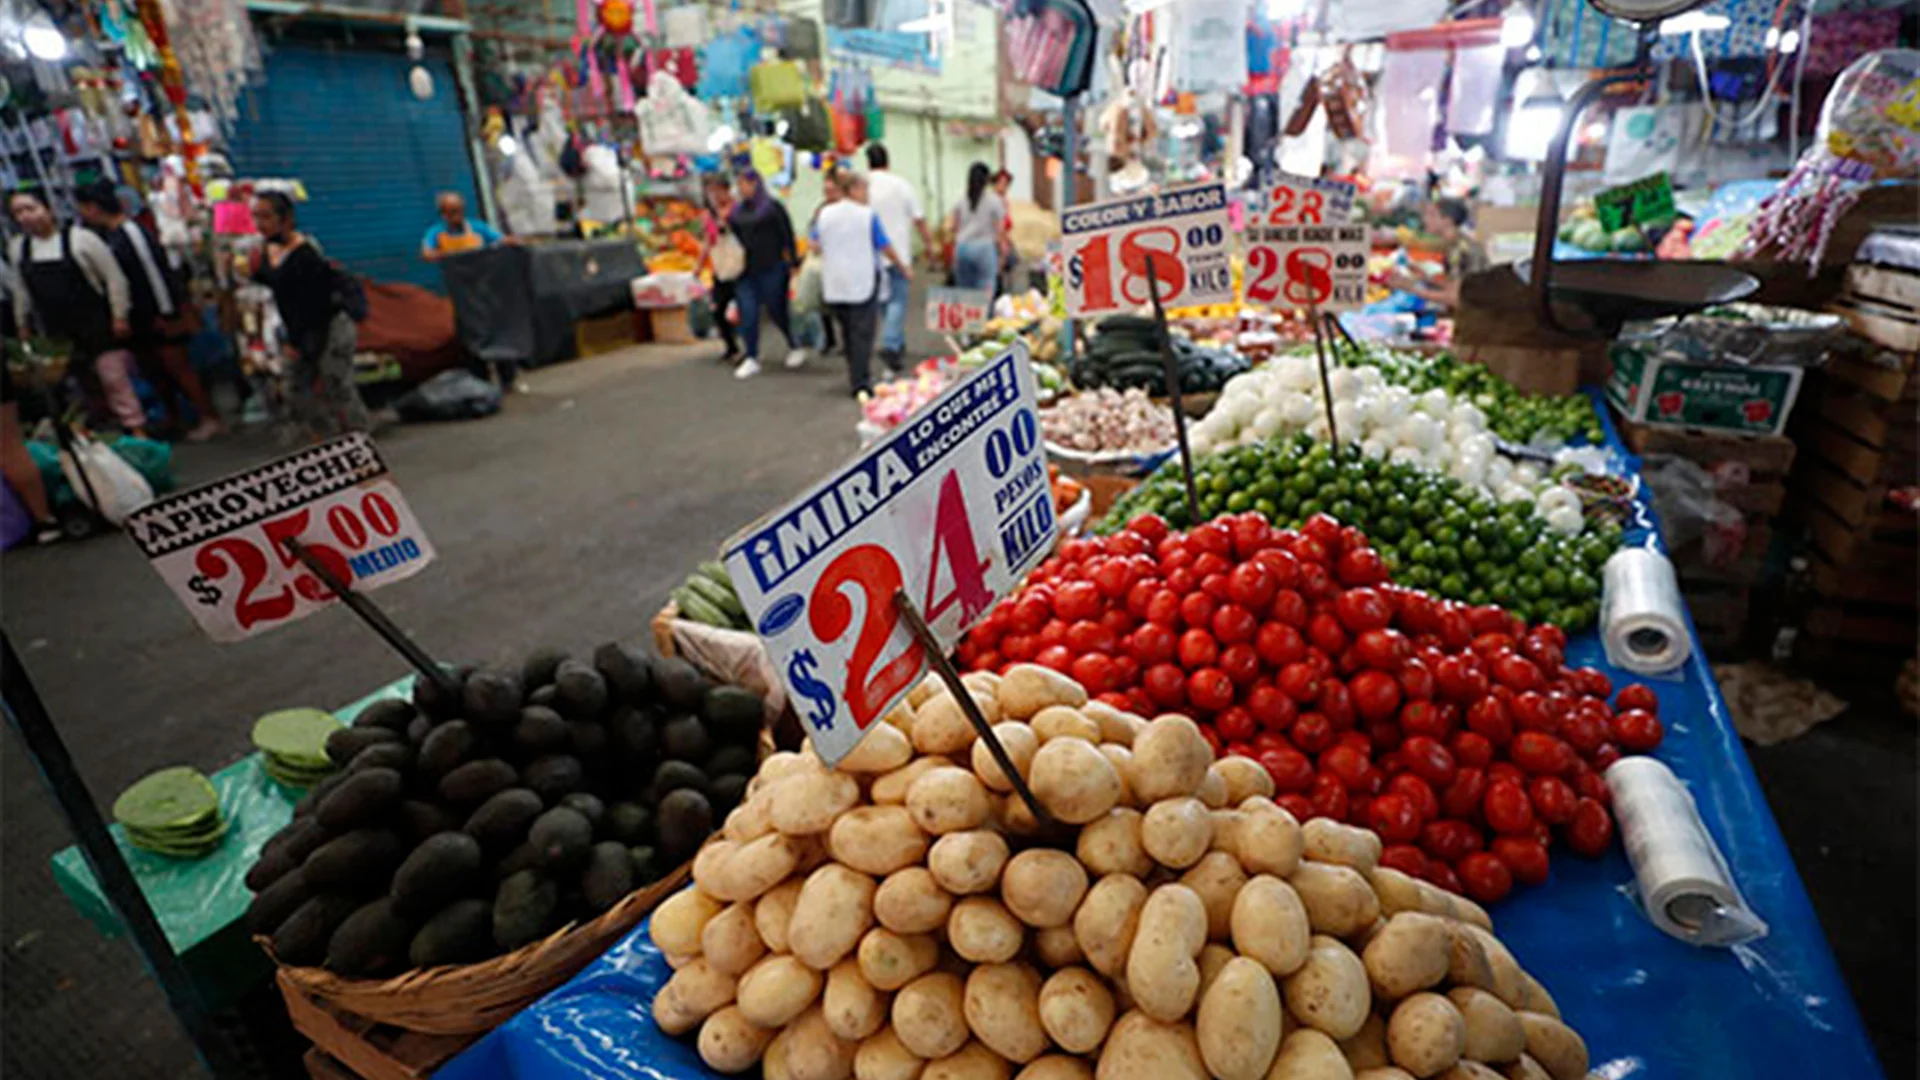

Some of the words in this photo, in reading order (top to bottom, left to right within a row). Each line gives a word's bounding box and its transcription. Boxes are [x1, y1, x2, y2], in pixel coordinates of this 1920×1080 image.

[1065, 207, 1129, 232] COLOR
[1133, 200, 1149, 218] Y
[1154, 189, 1222, 215] SABOR
[1187, 223, 1224, 249] 00
[1246, 245, 1333, 304] 28
[1335, 253, 1366, 269] 00
[908, 419, 935, 447] LO
[936, 388, 971, 425] QUE
[974, 370, 998, 398] ME
[985, 407, 1037, 479] 00
[147, 447, 371, 544] APROVECHE
[994, 458, 1043, 515] PESOS
[327, 491, 400, 551] 00
[1001, 496, 1053, 568] KILO
[348, 537, 422, 580] MEDIO
